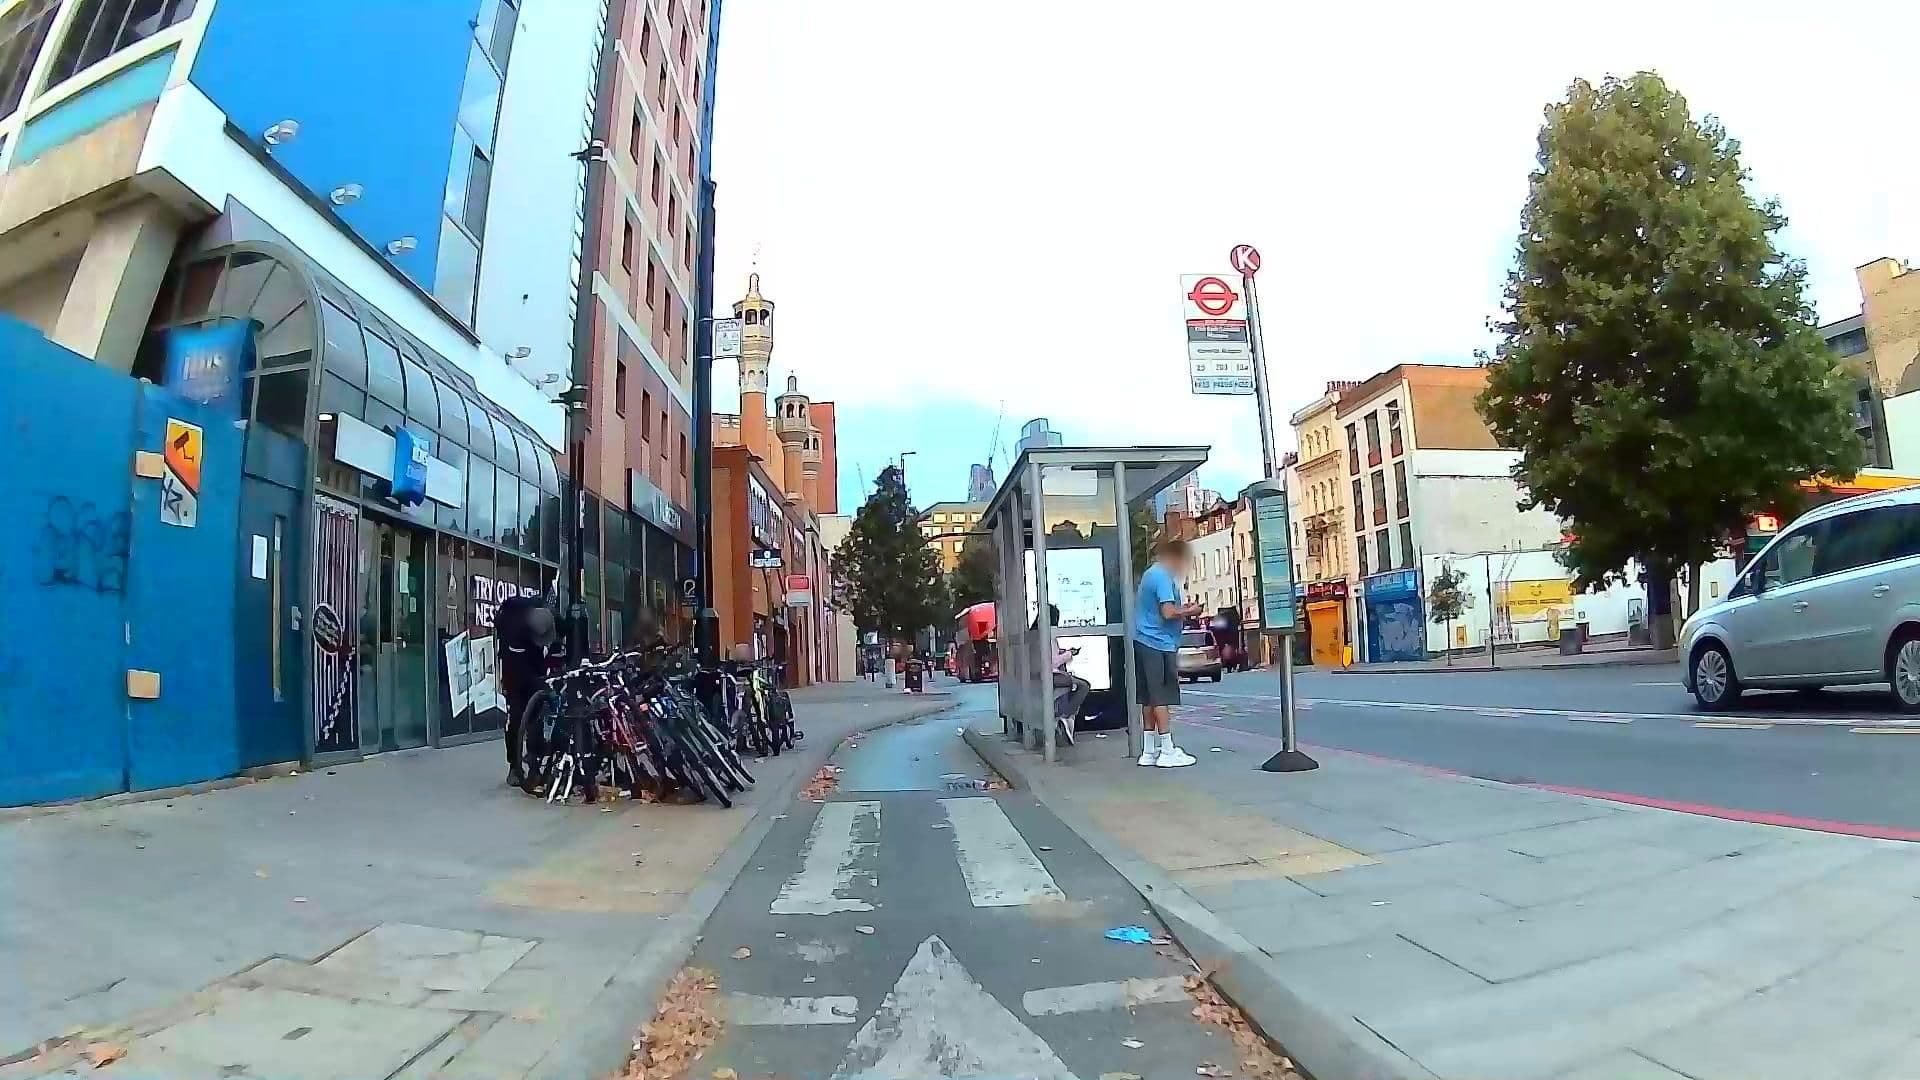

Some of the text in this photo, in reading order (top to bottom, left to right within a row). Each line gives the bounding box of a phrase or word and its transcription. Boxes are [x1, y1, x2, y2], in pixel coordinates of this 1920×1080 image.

[1236, 247, 1259, 270] K
[473, 575, 494, 602] TRY
[475, 602, 501, 628] NES
